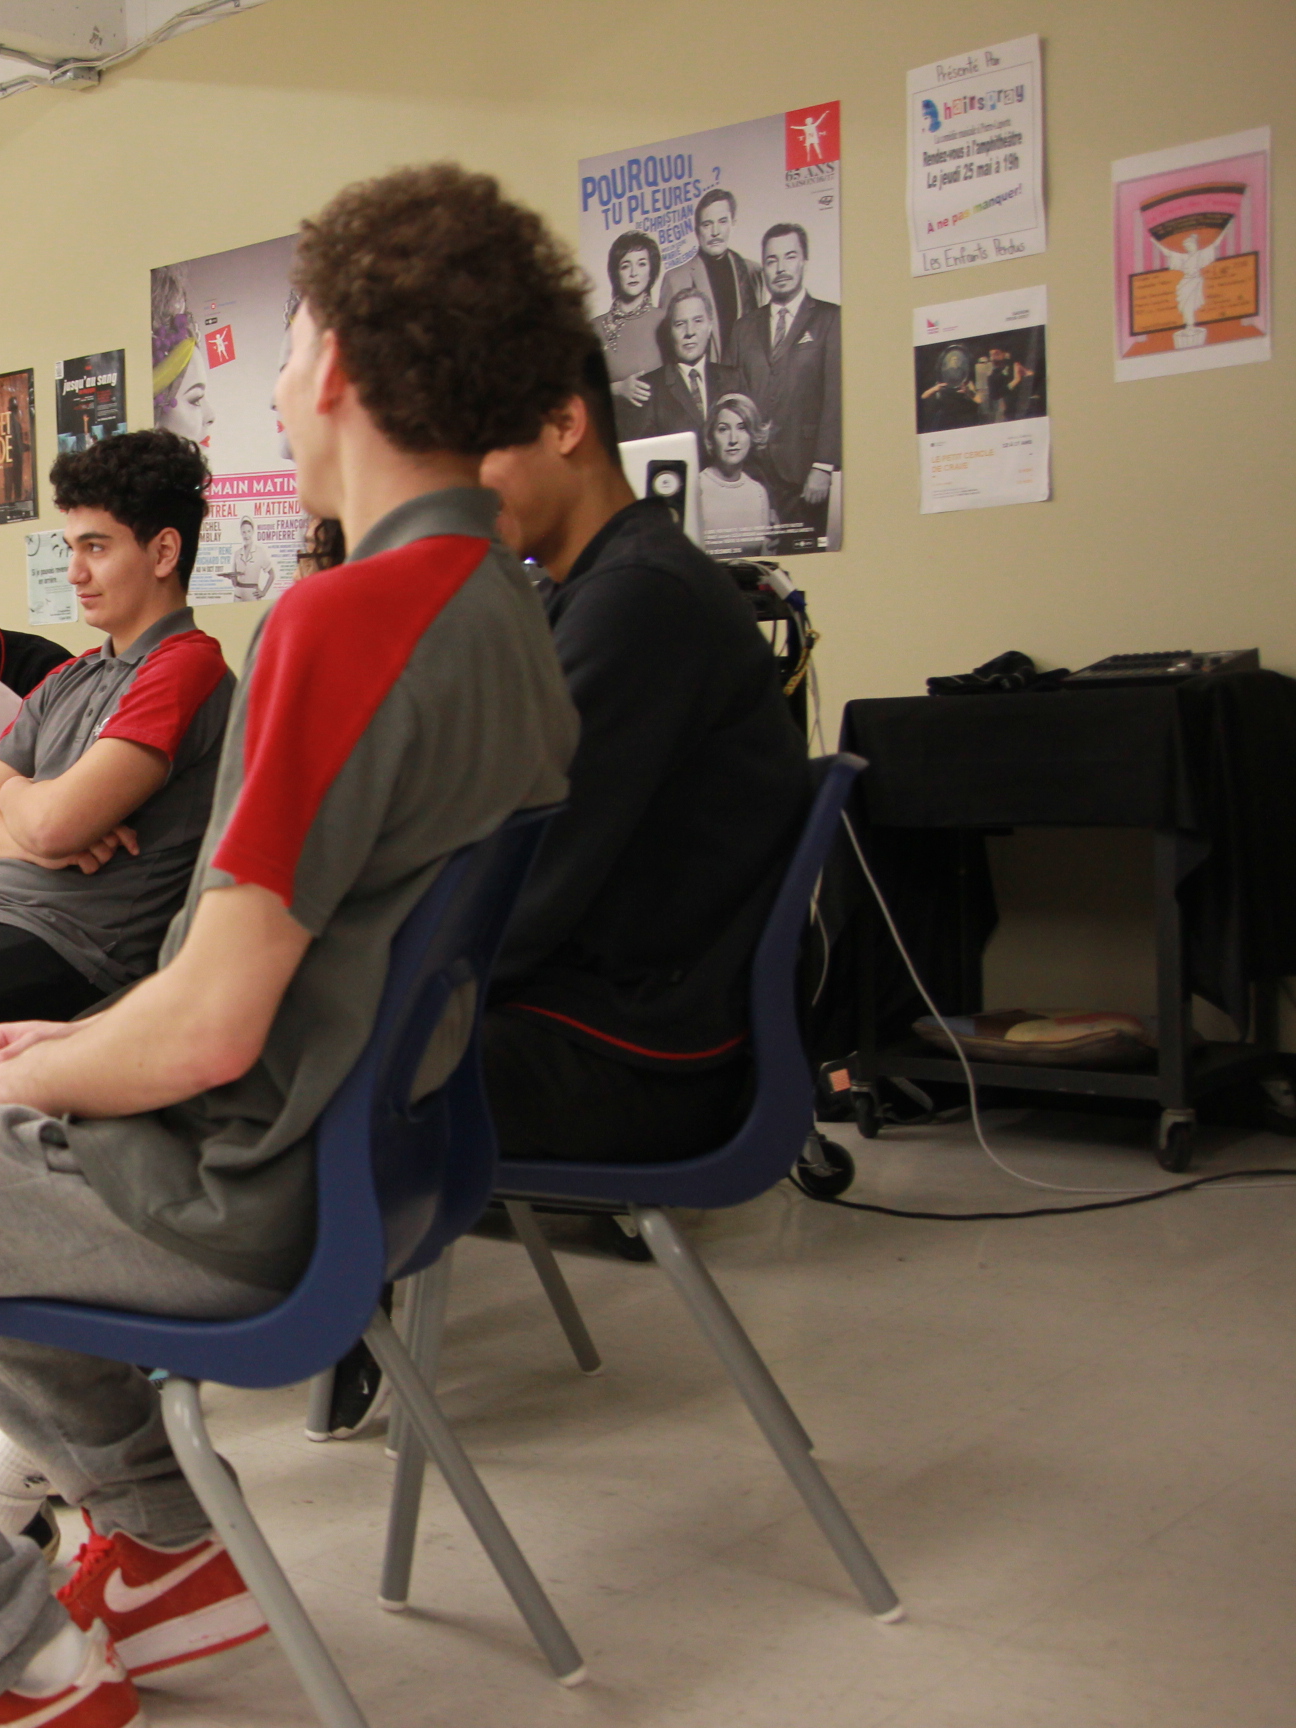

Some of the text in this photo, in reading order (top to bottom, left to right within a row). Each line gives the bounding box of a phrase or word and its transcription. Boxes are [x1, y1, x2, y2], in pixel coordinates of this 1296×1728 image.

[582, 153, 693, 212] POURQUOI
[927, 172, 937, 189] Le
[939, 166, 961, 190] jeudi
[963, 162, 974, 181] 25
[976, 158, 992, 178] mai
[1004, 152, 1020, 171] 19h
[601, 201, 623, 231] TU
[644, 204, 693, 232] CHRISTIAN
[937, 218, 949, 230] ne
[952, 209, 971, 225] pas
[973, 183, 1023, 214] manquer!
[659, 218, 694, 245] BÉGIN
[923, 252, 942, 271] Les
[62, 376, 96, 396] jusqu'au
[97, 373, 118, 387] sang
[204, 480, 248, 496] EMAIN
[208, 501, 238, 518] TRÉAL
[200, 532, 222, 543] MBLAY
[201, 521, 222, 533] ICHEL
[257, 530, 296, 542] DOMPIERRE
